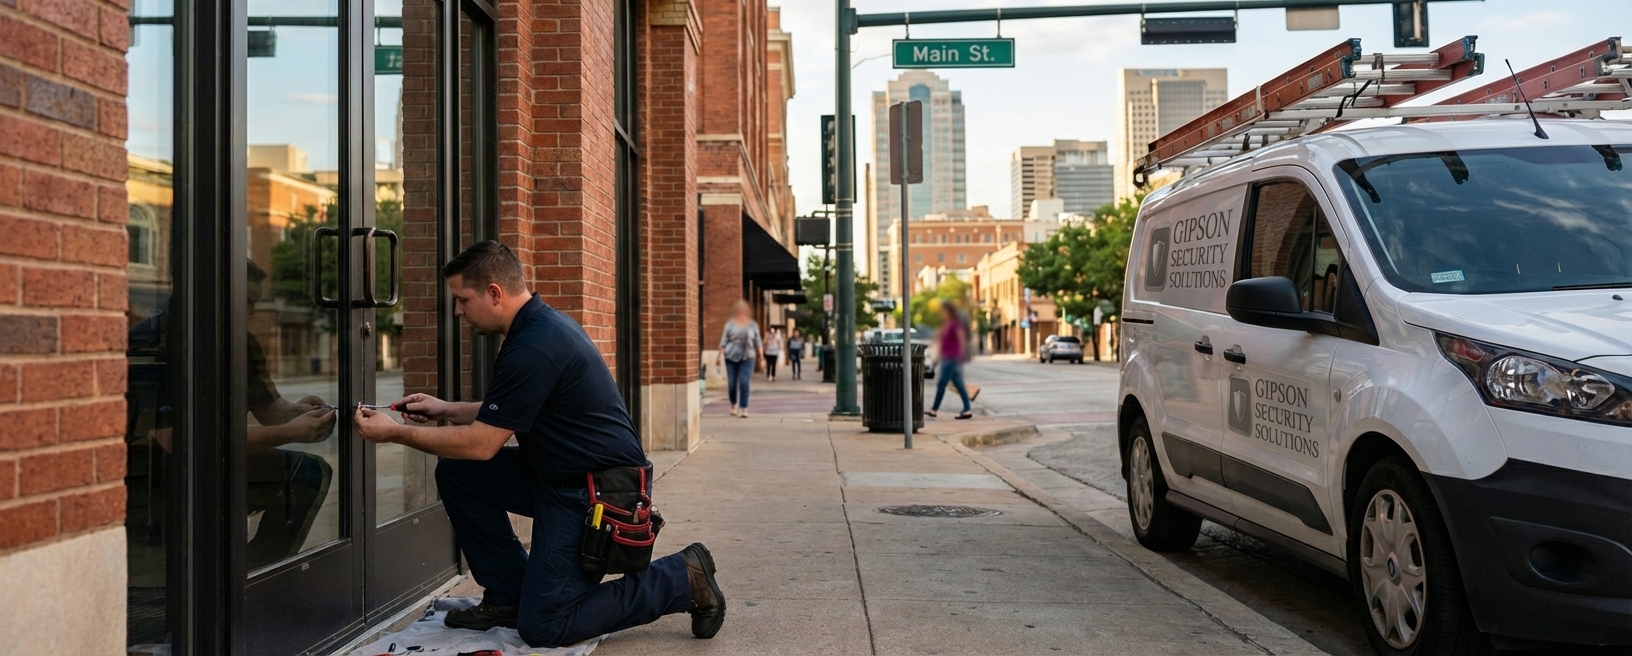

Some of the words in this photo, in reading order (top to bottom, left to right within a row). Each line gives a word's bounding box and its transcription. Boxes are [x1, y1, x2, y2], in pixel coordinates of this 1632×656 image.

[913, 45, 959, 62] Main
[969, 45, 995, 62] St.
[1173, 209, 1233, 244] GIPSON
[1170, 243, 1228, 267] SECURITY
[1255, 378, 1309, 408] GIPSON
[1255, 402, 1314, 433] SECURITY
[1255, 423, 1319, 458] SOLUTIONS
